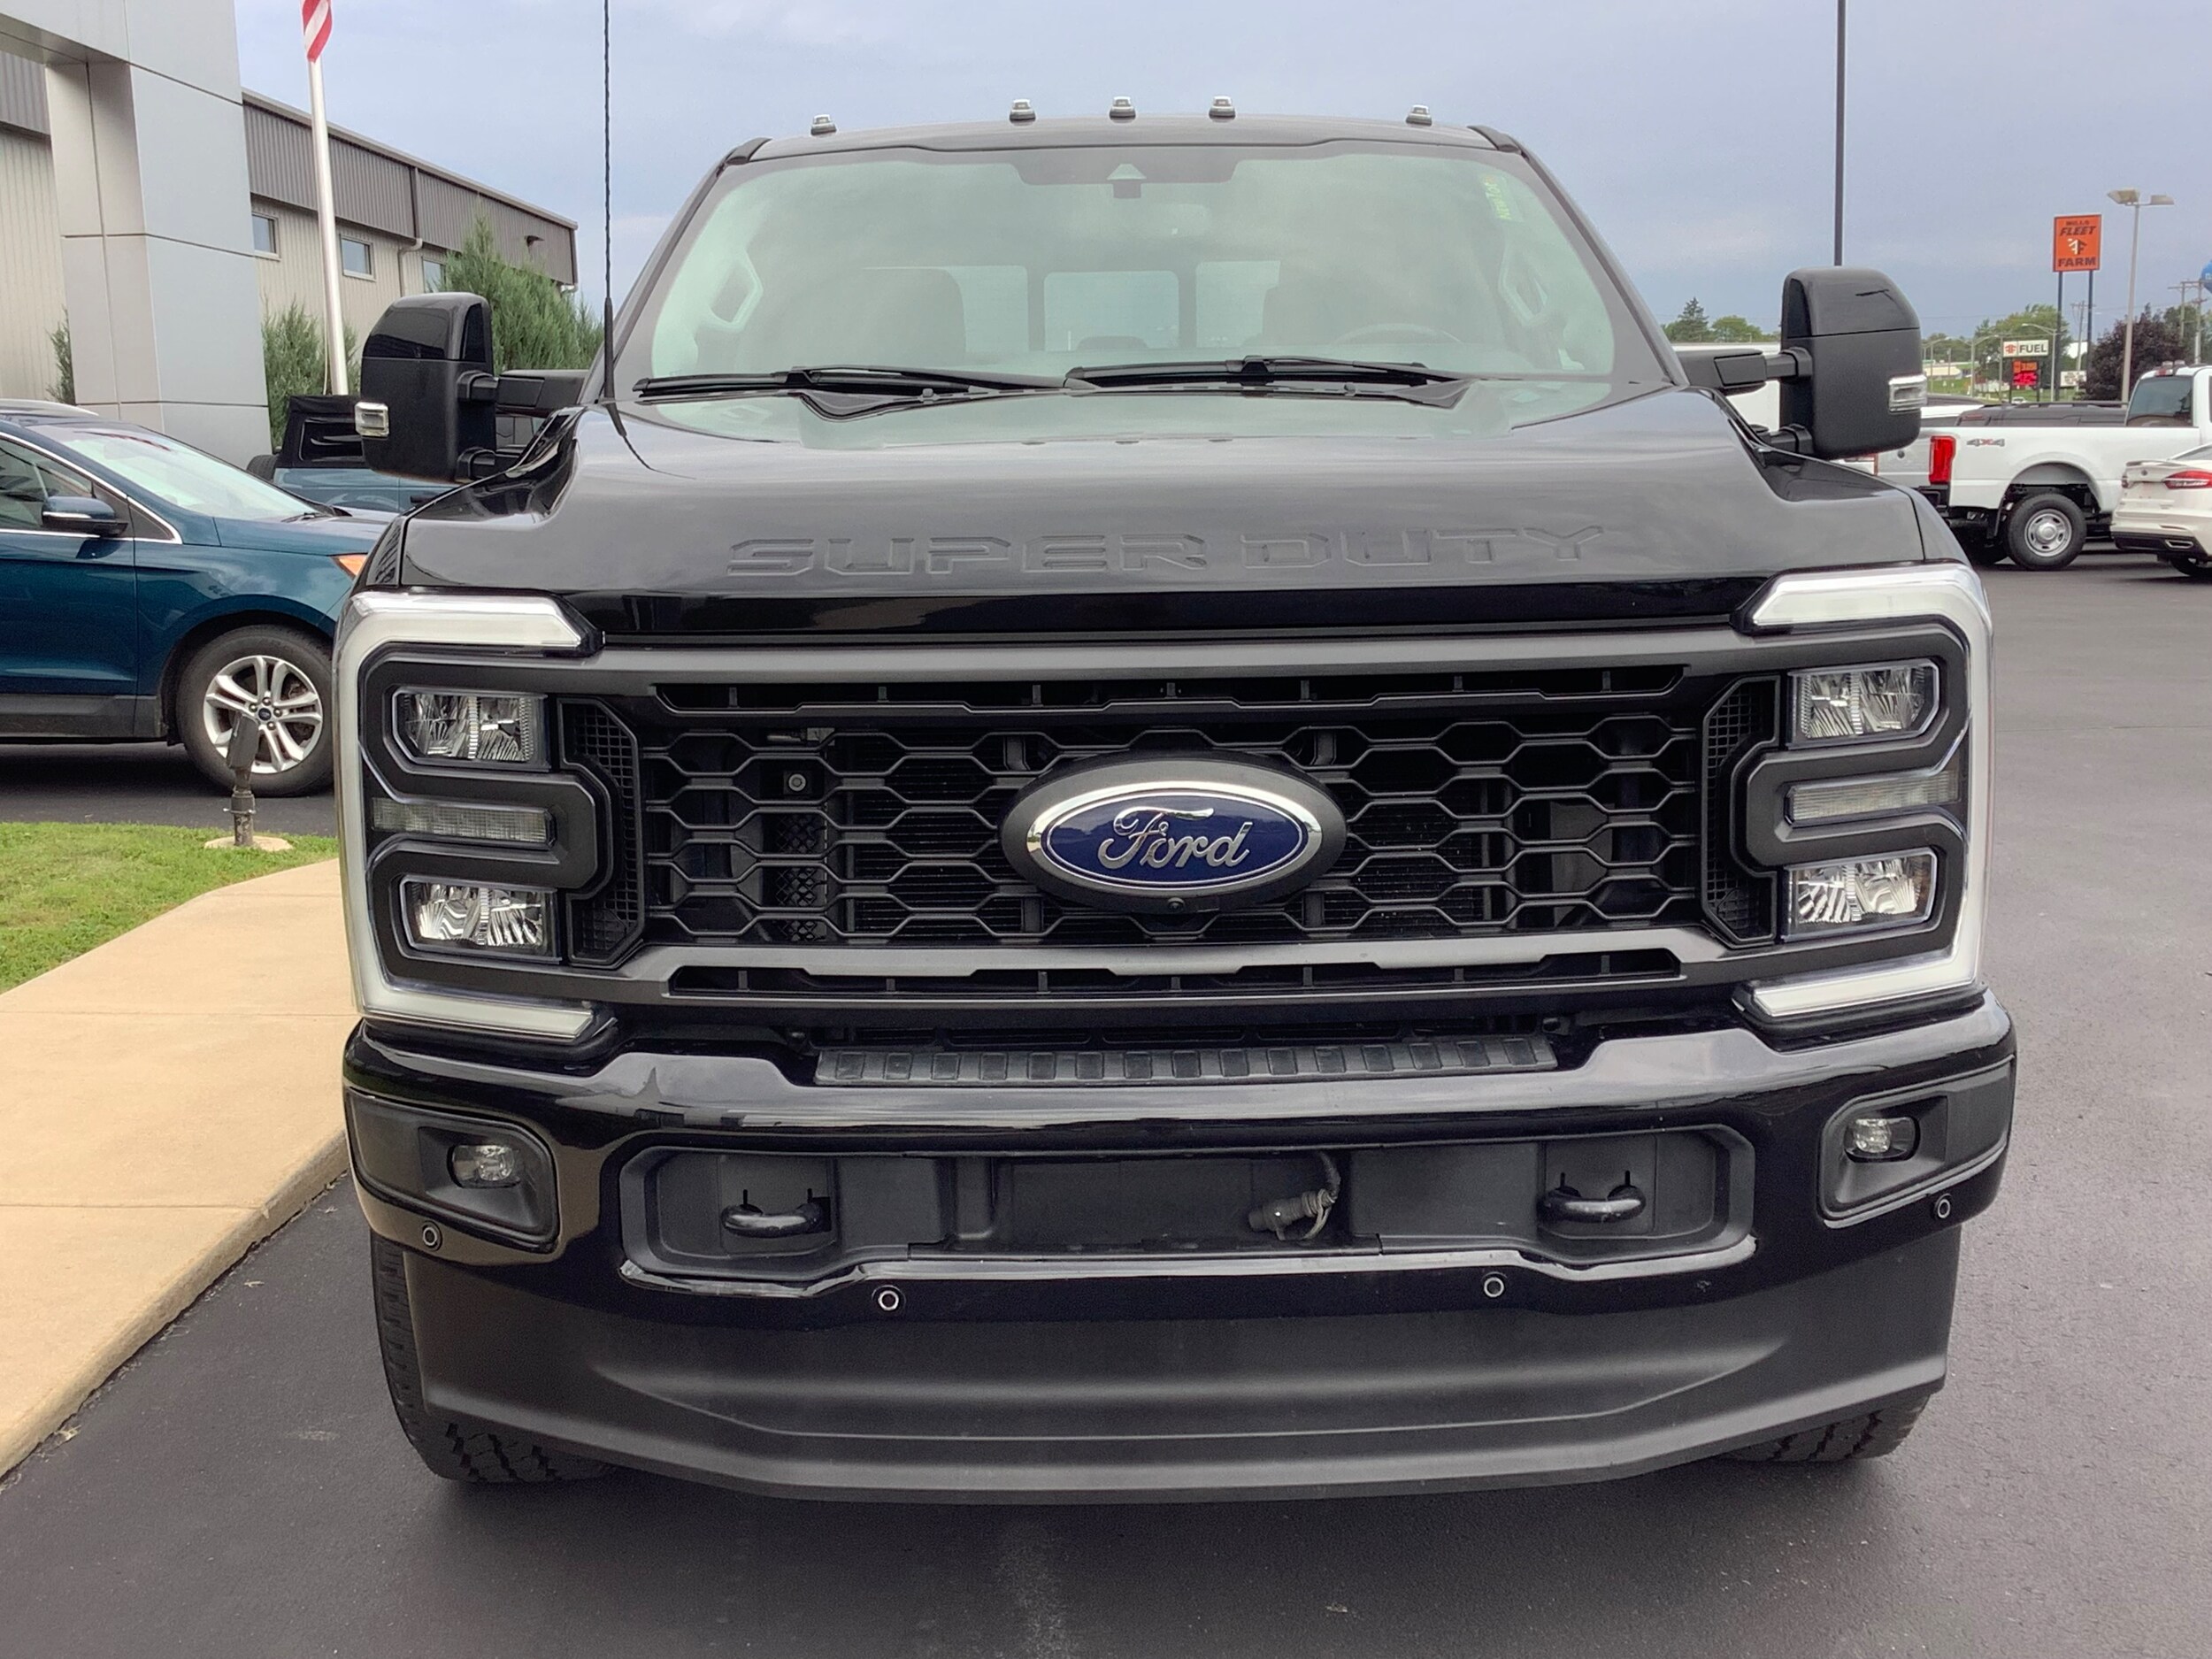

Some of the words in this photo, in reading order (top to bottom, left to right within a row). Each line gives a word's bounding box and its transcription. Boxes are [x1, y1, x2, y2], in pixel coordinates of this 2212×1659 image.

[2060, 226, 2096, 236] FLEET
[2058, 257, 2096, 266] FARM
[2019, 344, 2047, 353] FUEL
[726, 534, 1208, 576] SUPER
[1240, 525, 1604, 569] DUTY
[1097, 806, 1252, 870] Ford
